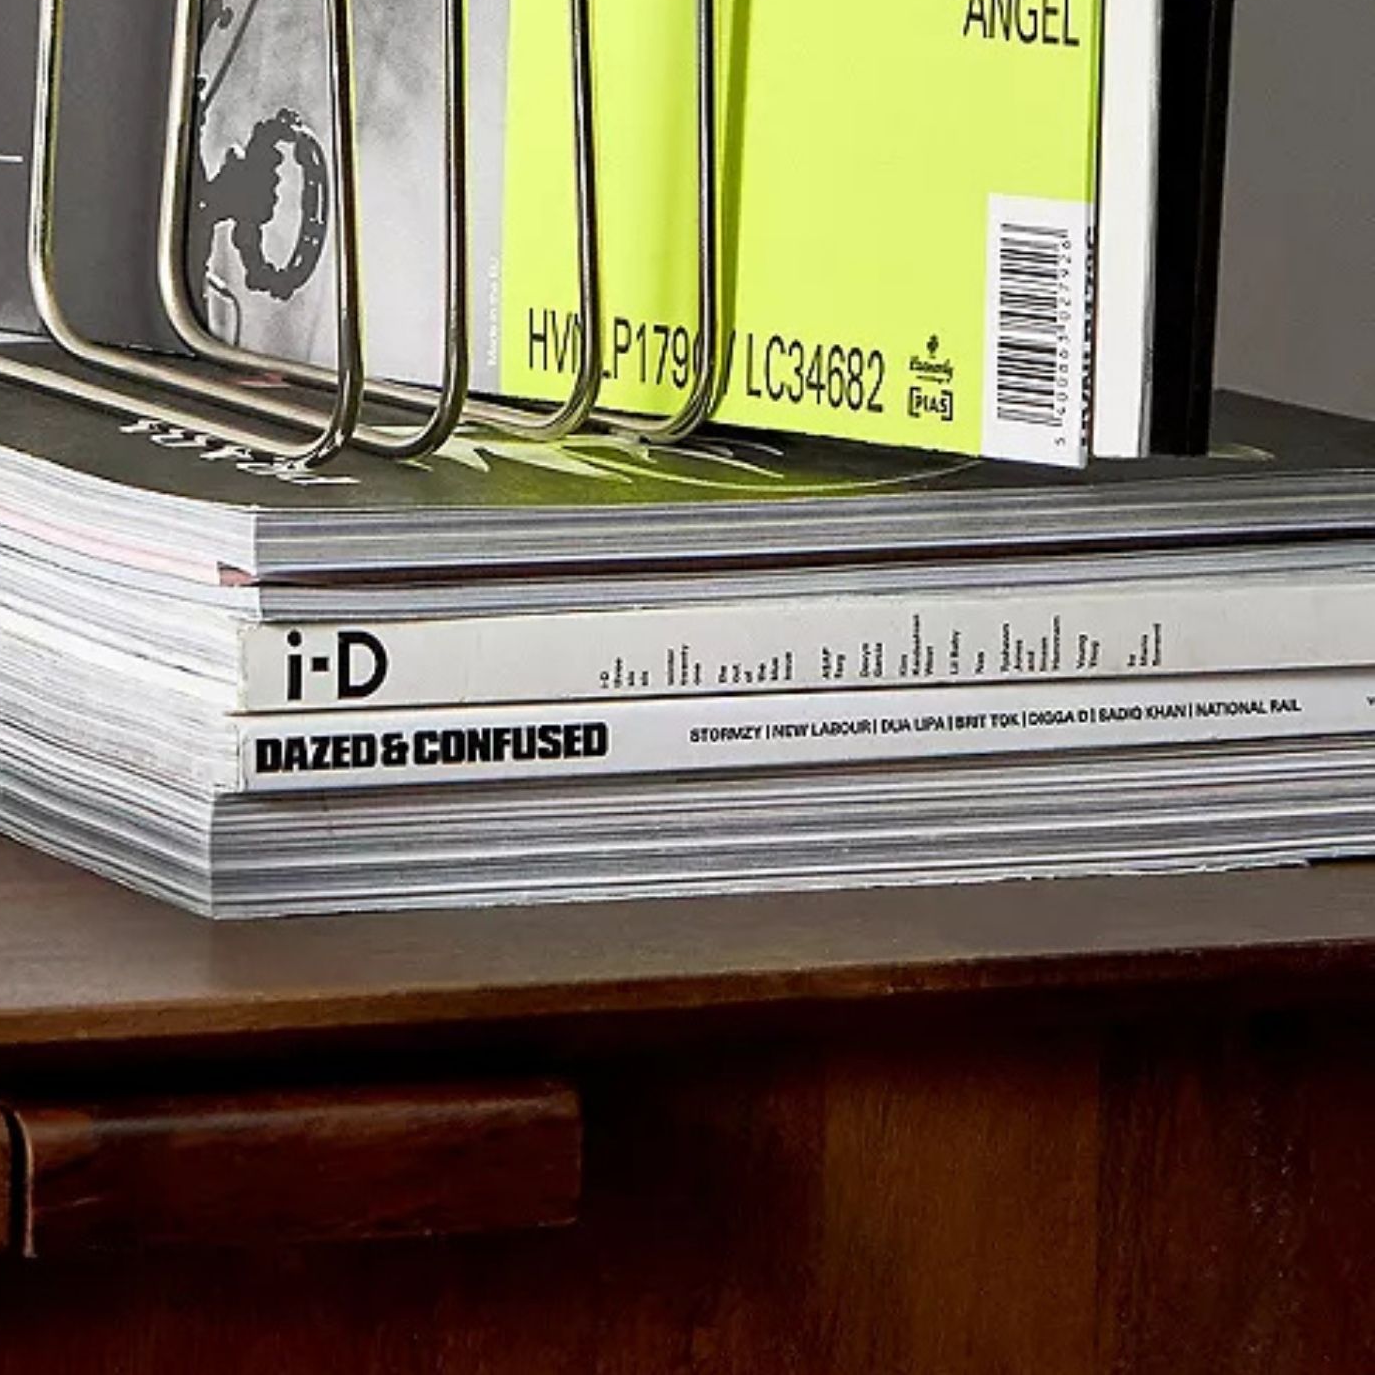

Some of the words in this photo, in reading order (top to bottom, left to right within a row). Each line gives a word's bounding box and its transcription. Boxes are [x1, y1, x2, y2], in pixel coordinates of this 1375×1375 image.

[747, 333, 885, 414] LC34682
[286, 629, 388, 701] i-D
[255, 735, 378, 773] DAZED
[413, 721, 609, 765] CONFUSED
[690, 724, 763, 744] STORMZY
[773, 724, 809, 740] NEW
[811, 720, 872, 738] LABOUR
[881, 718, 910, 734] DUA
[915, 716, 946, 732] LIPA
[1145, 704, 1187, 721] KHAN
[1195, 701, 1268, 718] NATIONAL
[1269, 699, 1302, 713] RAIL
